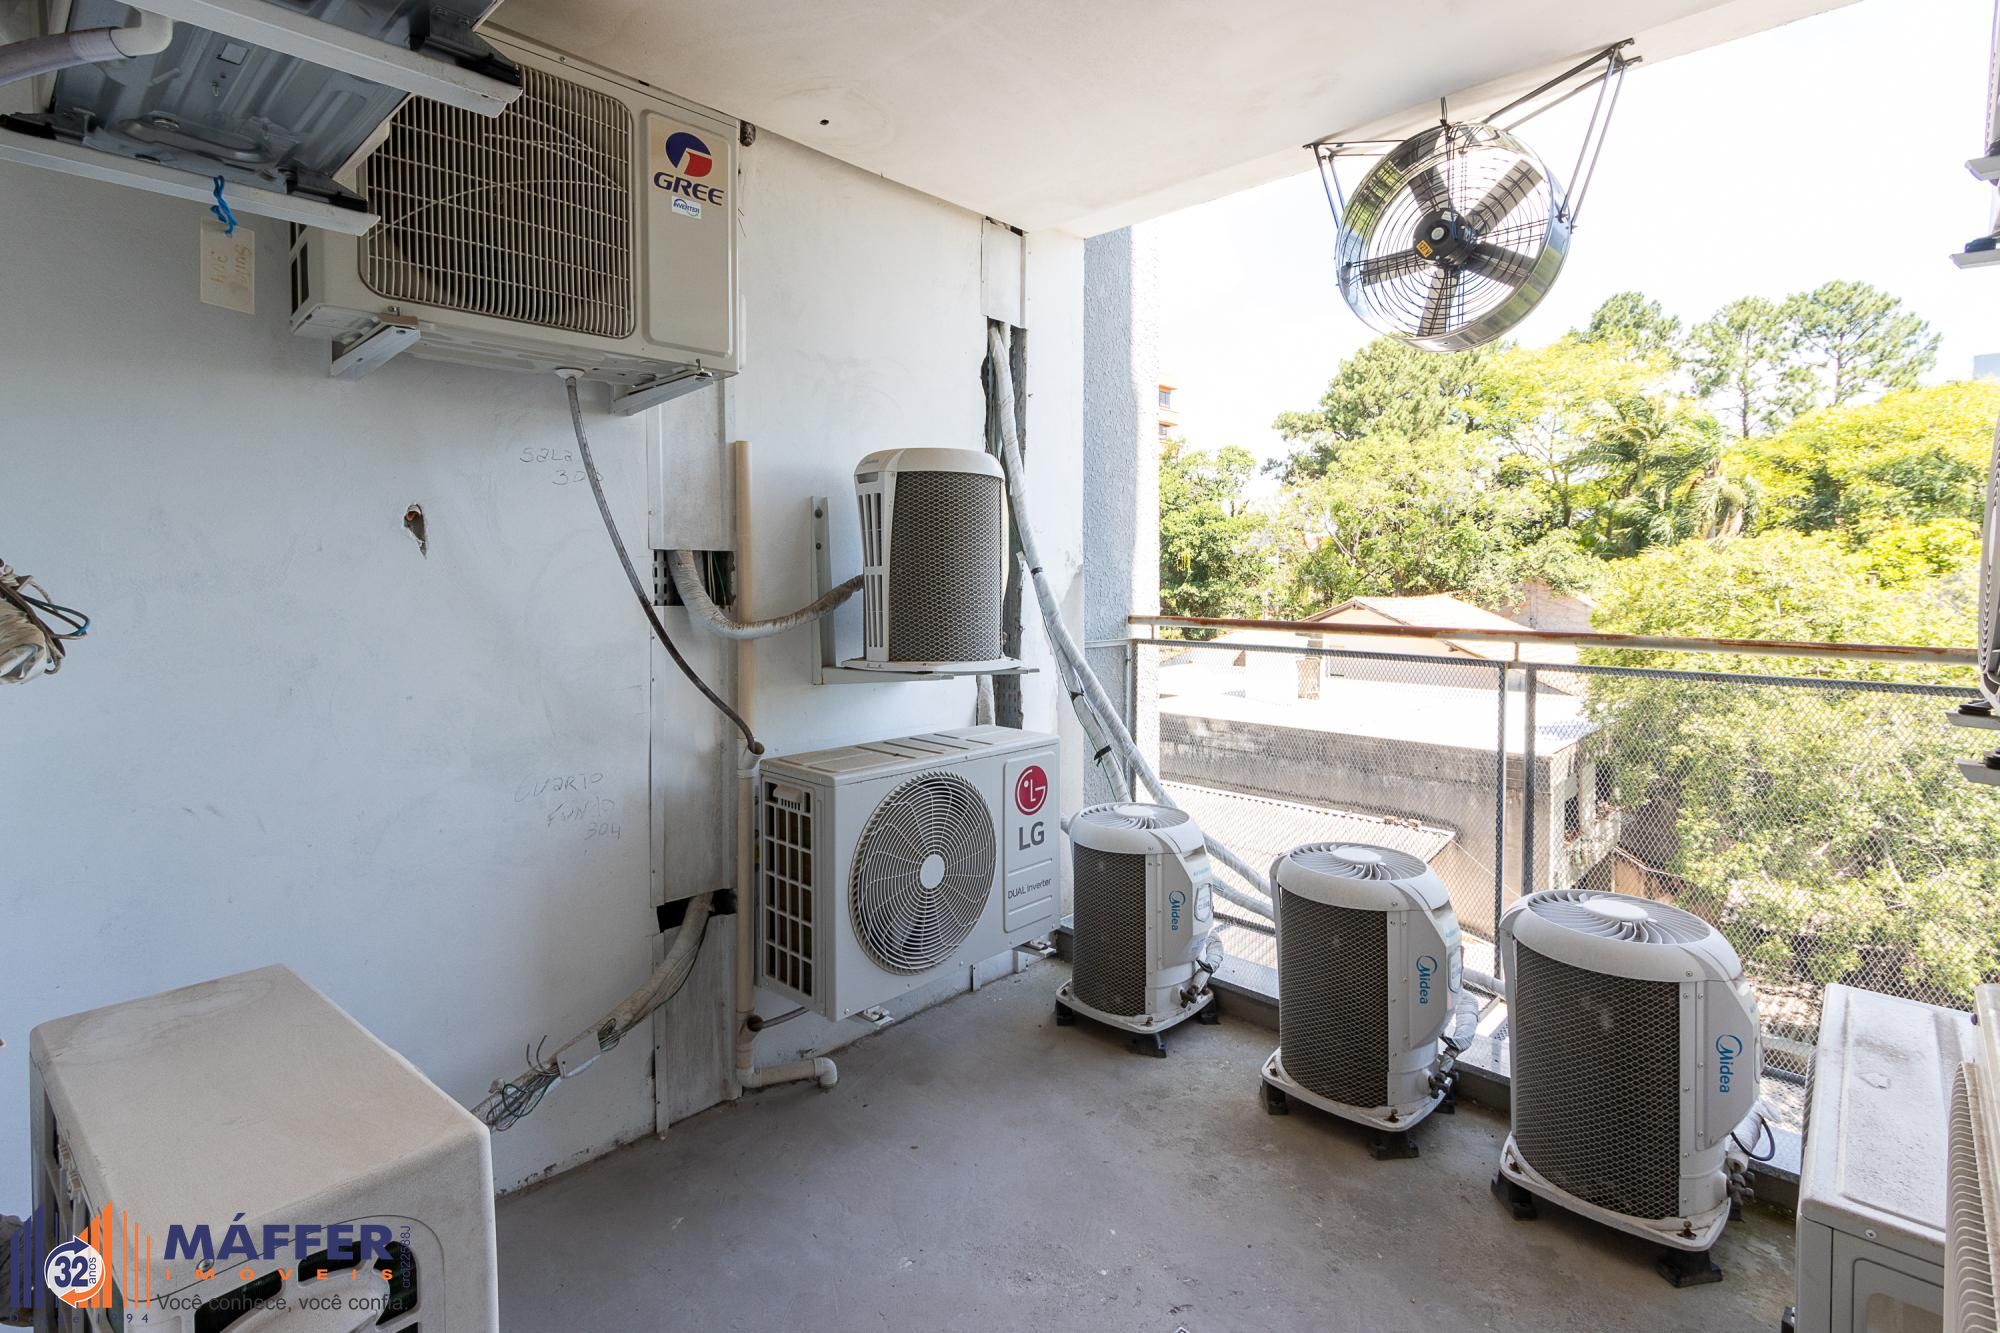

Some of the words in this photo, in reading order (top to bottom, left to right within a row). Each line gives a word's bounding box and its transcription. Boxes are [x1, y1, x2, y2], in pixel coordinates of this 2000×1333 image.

[653, 171, 725, 207] GREE
[1019, 821, 1045, 851] LG
[1007, 885, 1026, 900] DUAL
[1026, 878, 1052, 893] Inverter
[1169, 890, 1186, 931] Midea
[1416, 955, 1437, 1004] Midea
[1715, 1034, 1743, 1093] Midea
